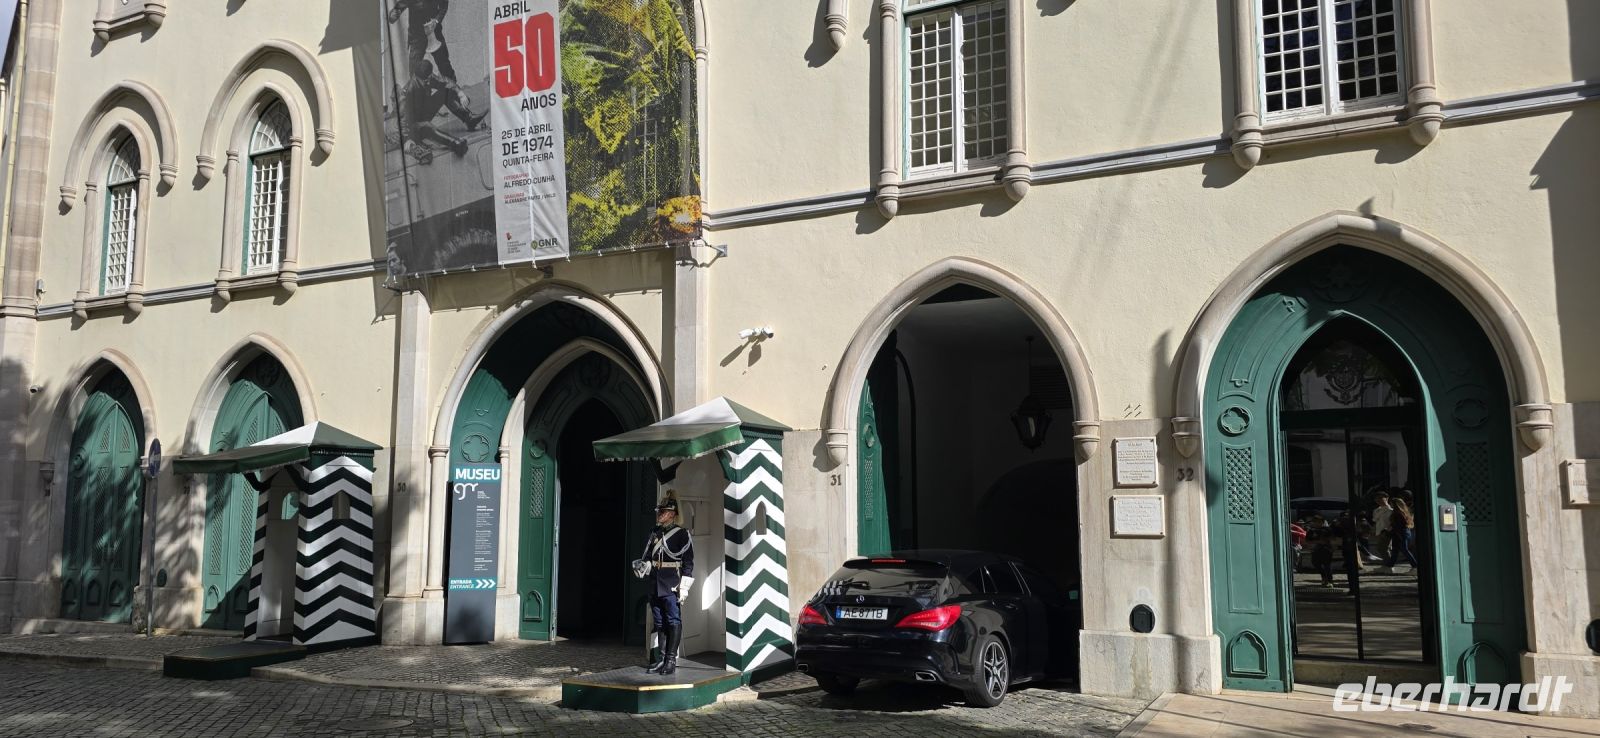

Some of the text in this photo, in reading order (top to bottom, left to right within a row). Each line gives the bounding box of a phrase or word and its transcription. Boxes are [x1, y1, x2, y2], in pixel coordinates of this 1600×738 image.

[494, 1, 531, 20] ABRIL
[494, 11, 556, 98] 50
[521, 93, 557, 112] ANOS
[501, 123, 554, 140] 25 DE ABRIL
[502, 135, 554, 156] DE 1974
[502, 152, 554, 168] QUINTA-FEIRA
[503, 174, 556, 189] ALFREDO CUNHA
[538, 237, 558, 247] GNR
[455, 468, 500, 480] MUSEU
[830, 474, 842, 486] 31
[1177, 467, 1194, 482] 32
